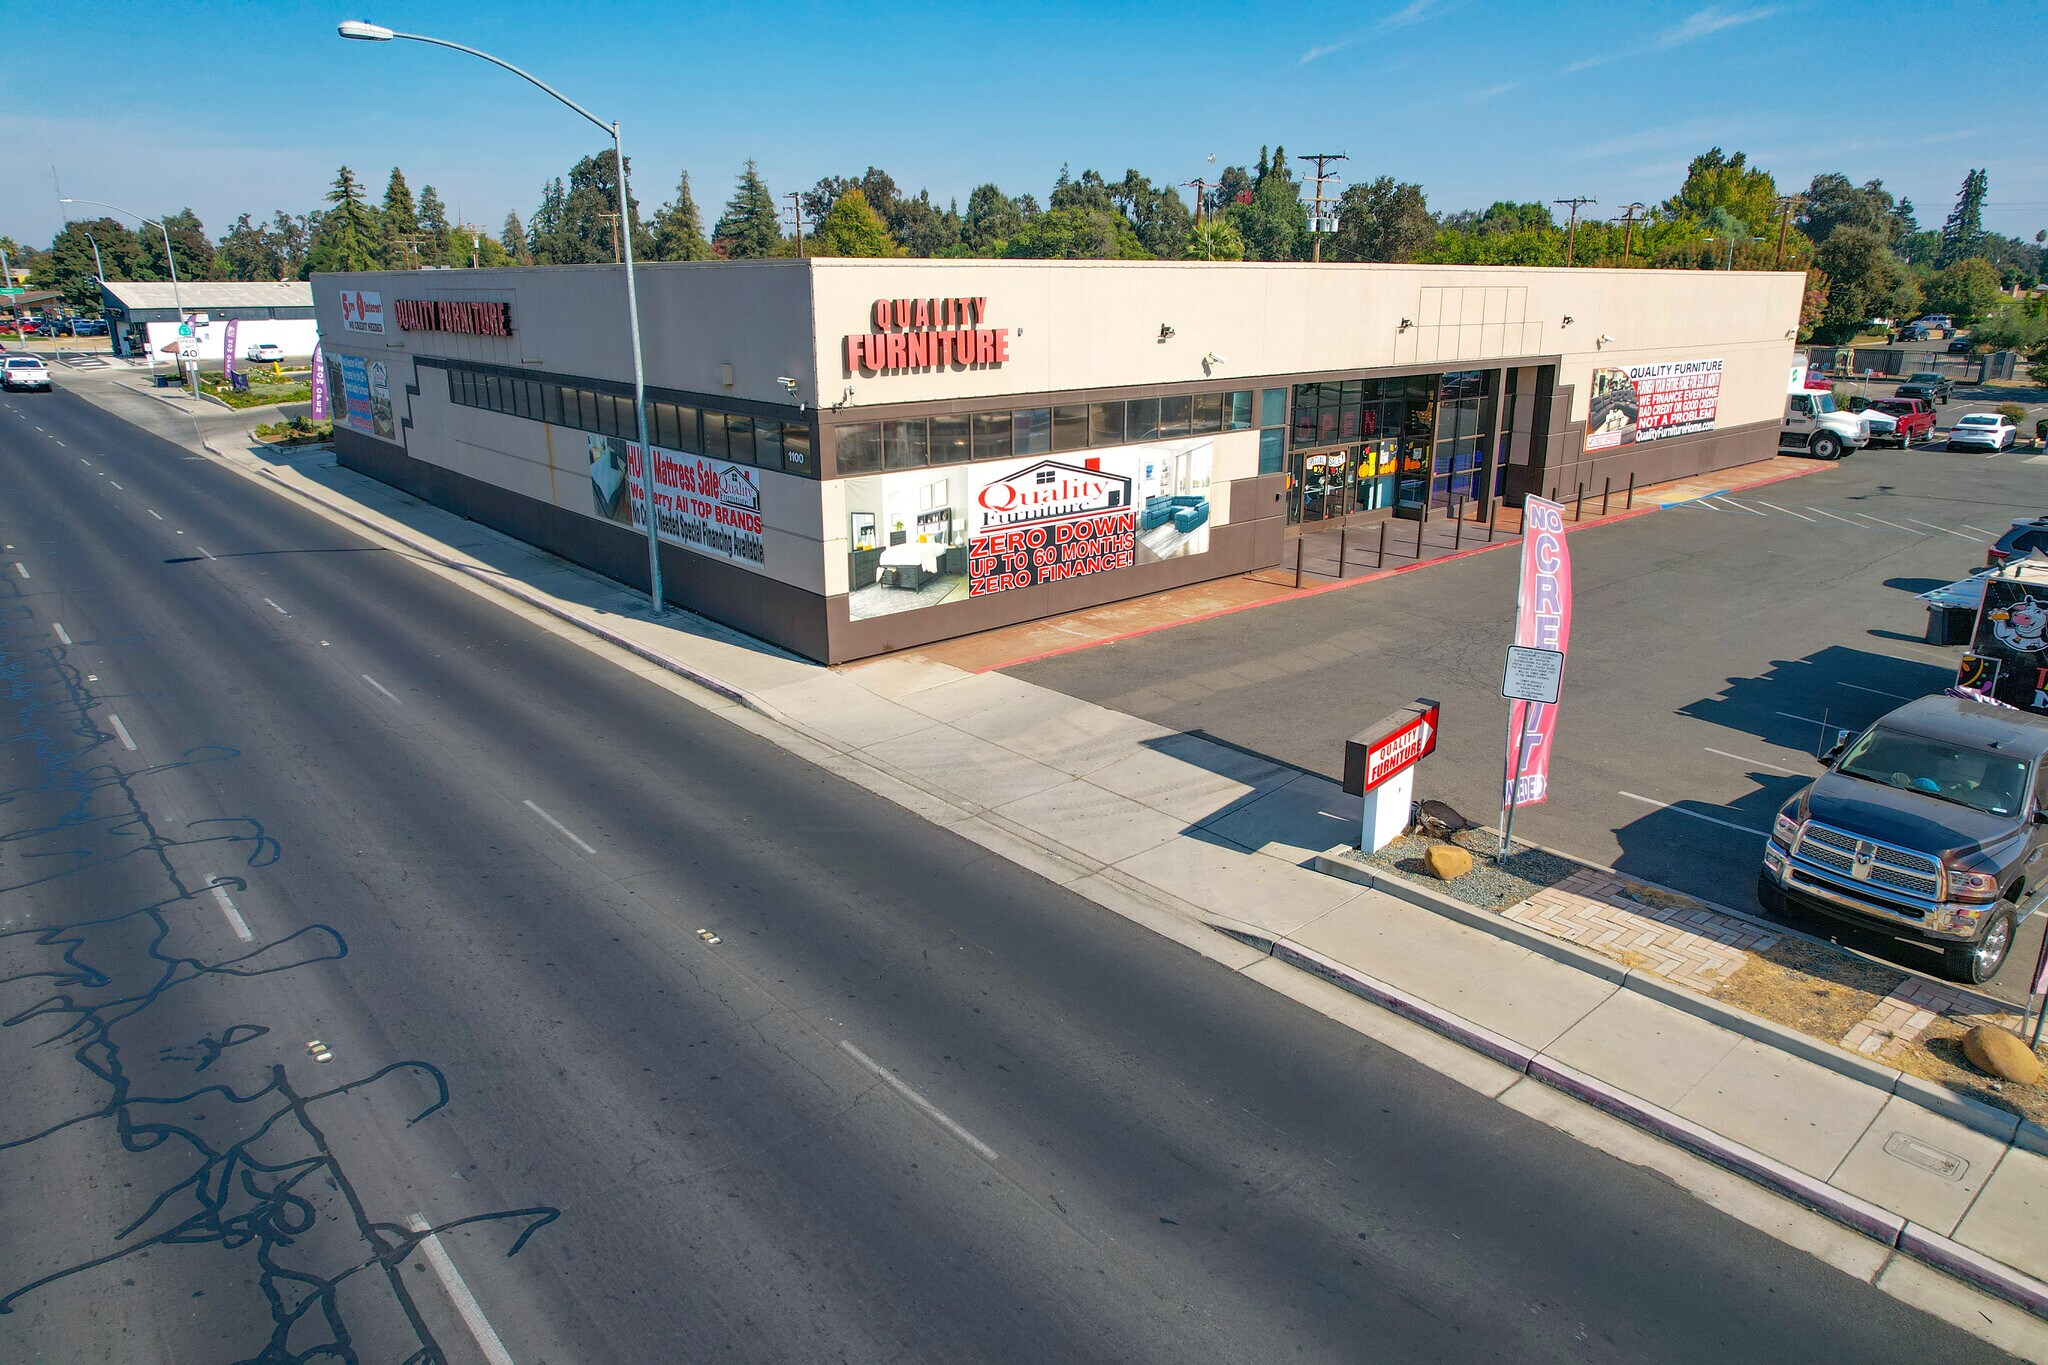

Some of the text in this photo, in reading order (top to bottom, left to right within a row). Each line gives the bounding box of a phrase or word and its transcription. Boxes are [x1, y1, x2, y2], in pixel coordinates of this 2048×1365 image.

[394, 299, 507, 337] QUALITY FURNITURE
[876, 296, 988, 331] QUALITY
[182, 349, 198, 358] 40
[226, 338, 234, 353] NOW
[847, 328, 1010, 372] FURNITURE
[315, 365, 325, 385] NOW
[1630, 360, 1723, 379] QUALITY FURNITURE
[315, 387, 323, 413] OPEN
[1639, 387, 1719, 406] WE FINANCE EVERYONE
[1639, 398, 1719, 417] BAD CREDIT OR GOOD CREDIT
[1298, 410, 1377, 442] OPEN
[1635, 420, 1715, 442] QualityFurnitureHome.com
[1638, 407, 1715, 429] NOT A PROBLEM!
[788, 451, 804, 464] 1100
[1307, 456, 1326, 467] SPECIAL
[653, 450, 696, 494] Mattress
[696, 459, 720, 500] Sale
[718, 474, 754, 501] Quality
[630, 481, 763, 535] We arry All TOP BRANDS
[720, 493, 750, 506] Furniture
[977, 477, 1110, 513] Quality
[982, 499, 1091, 526] Furniture
[1530, 505, 1564, 533] NO
[657, 508, 681, 537] Needed
[680, 515, 703, 545] Special
[702, 521, 734, 559] Financing
[733, 529, 764, 562] Available
[969, 513, 1135, 559] ZERO DOWN
[969, 532, 1135, 579] UP TO 60 MONTHS
[969, 550, 1134, 597] ZERO FINANCE!
[1520, 532, 1562, 771] CREIT
[1379, 727, 1418, 761] QUALITY
[1371, 738, 1423, 780] FURNITURE
